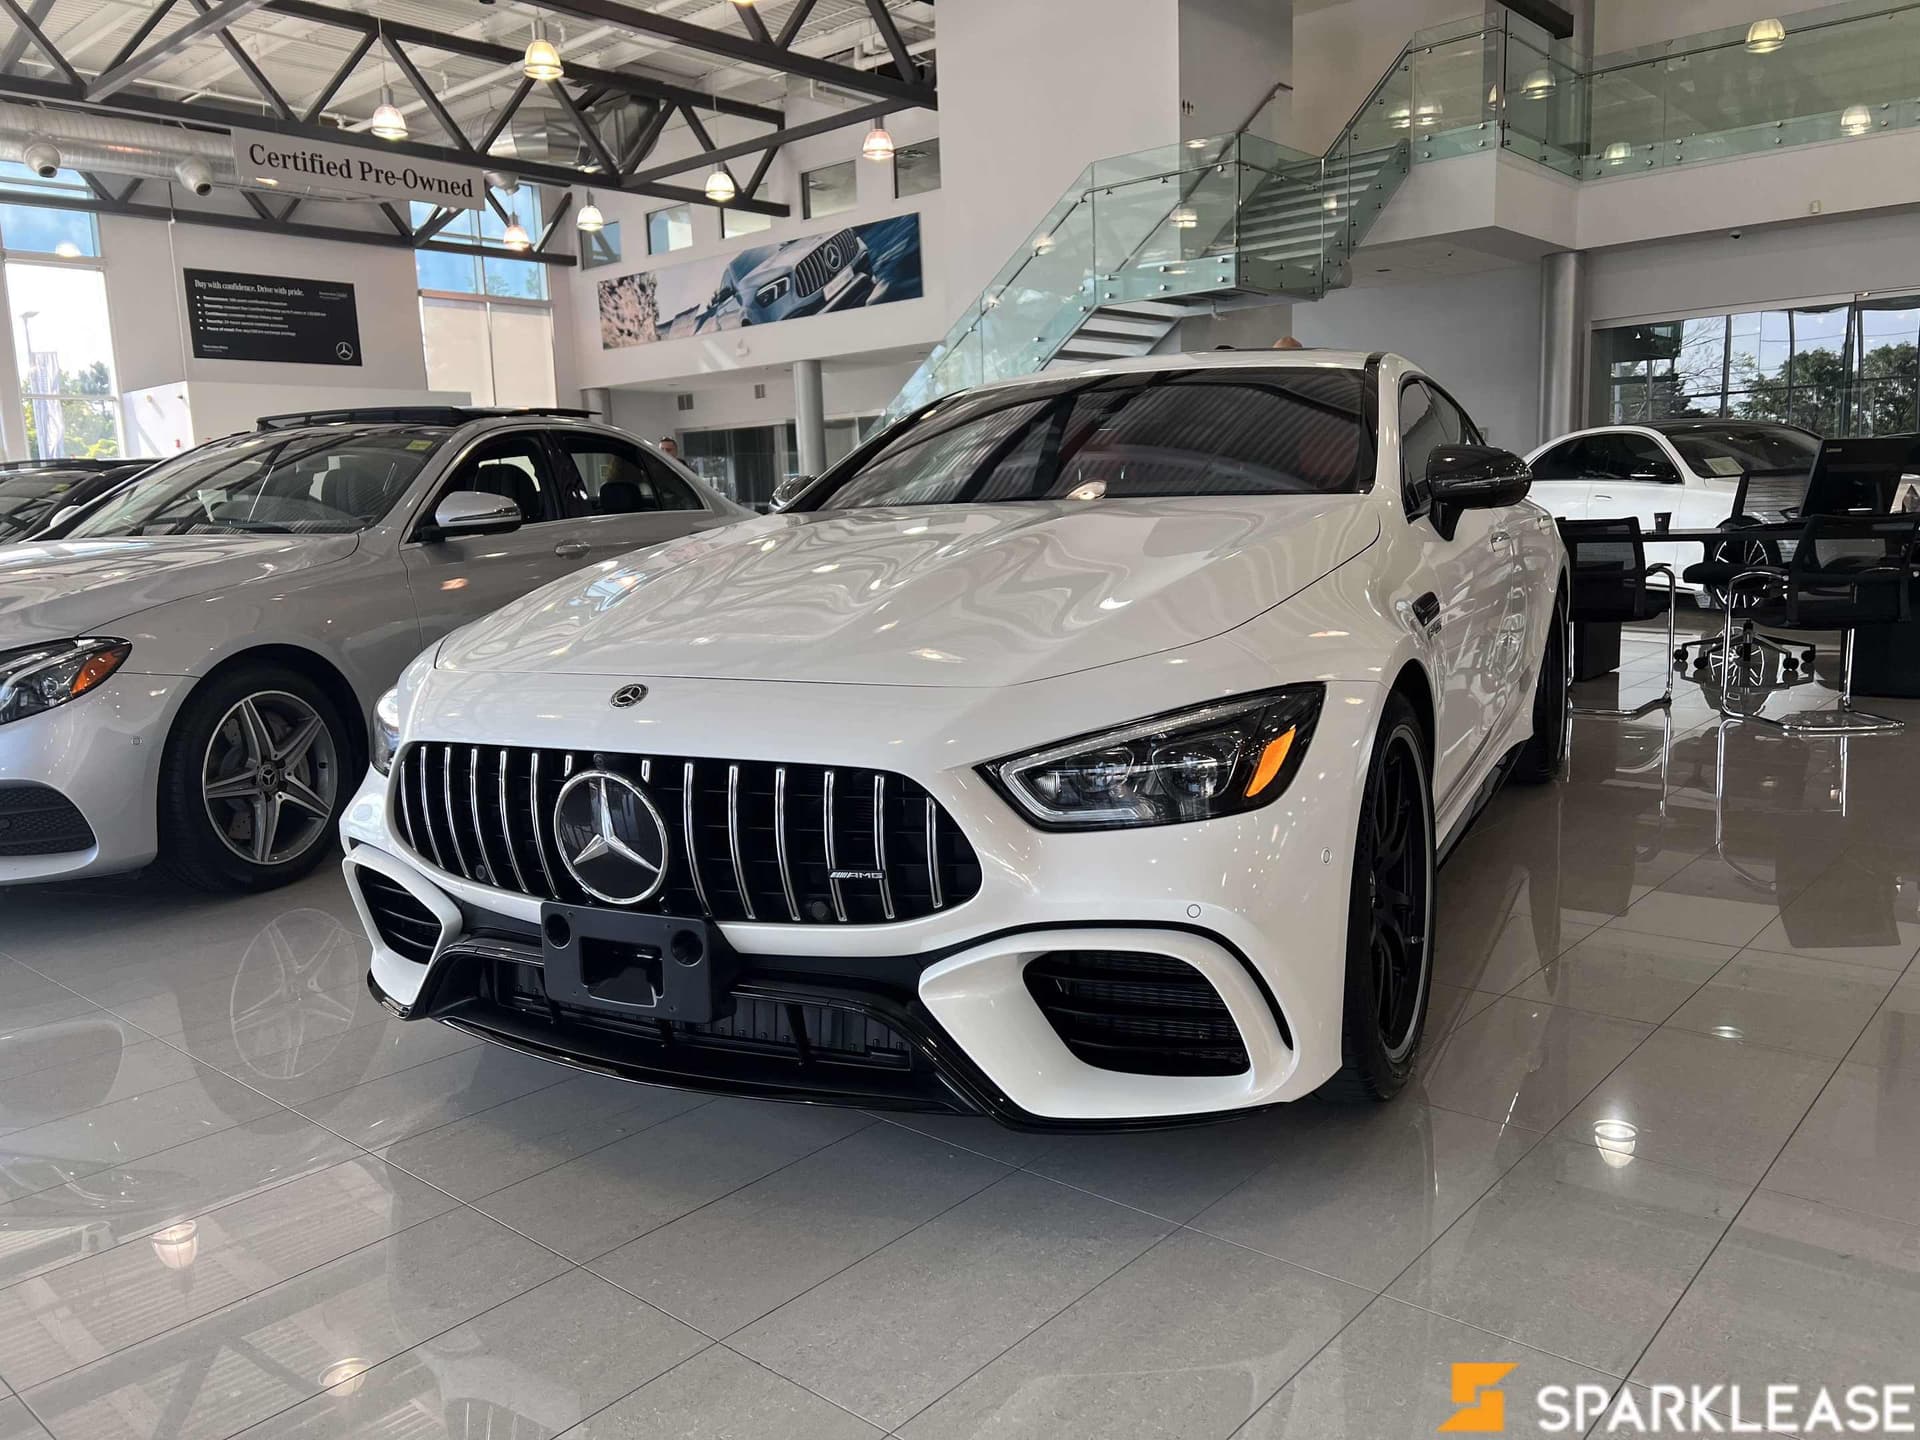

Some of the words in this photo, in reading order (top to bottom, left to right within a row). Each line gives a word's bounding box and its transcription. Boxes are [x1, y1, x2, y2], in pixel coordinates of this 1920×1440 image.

[249, 143, 352, 179] Certified
[358, 160, 474, 198] Pre-Owned
[195, 280, 207, 289] Buy
[208, 281, 221, 289] with
[222, 282, 256, 292] confidence.
[256, 284, 273, 293] Drive
[273, 286, 287, 294] with
[287, 287, 304, 297] pride.
